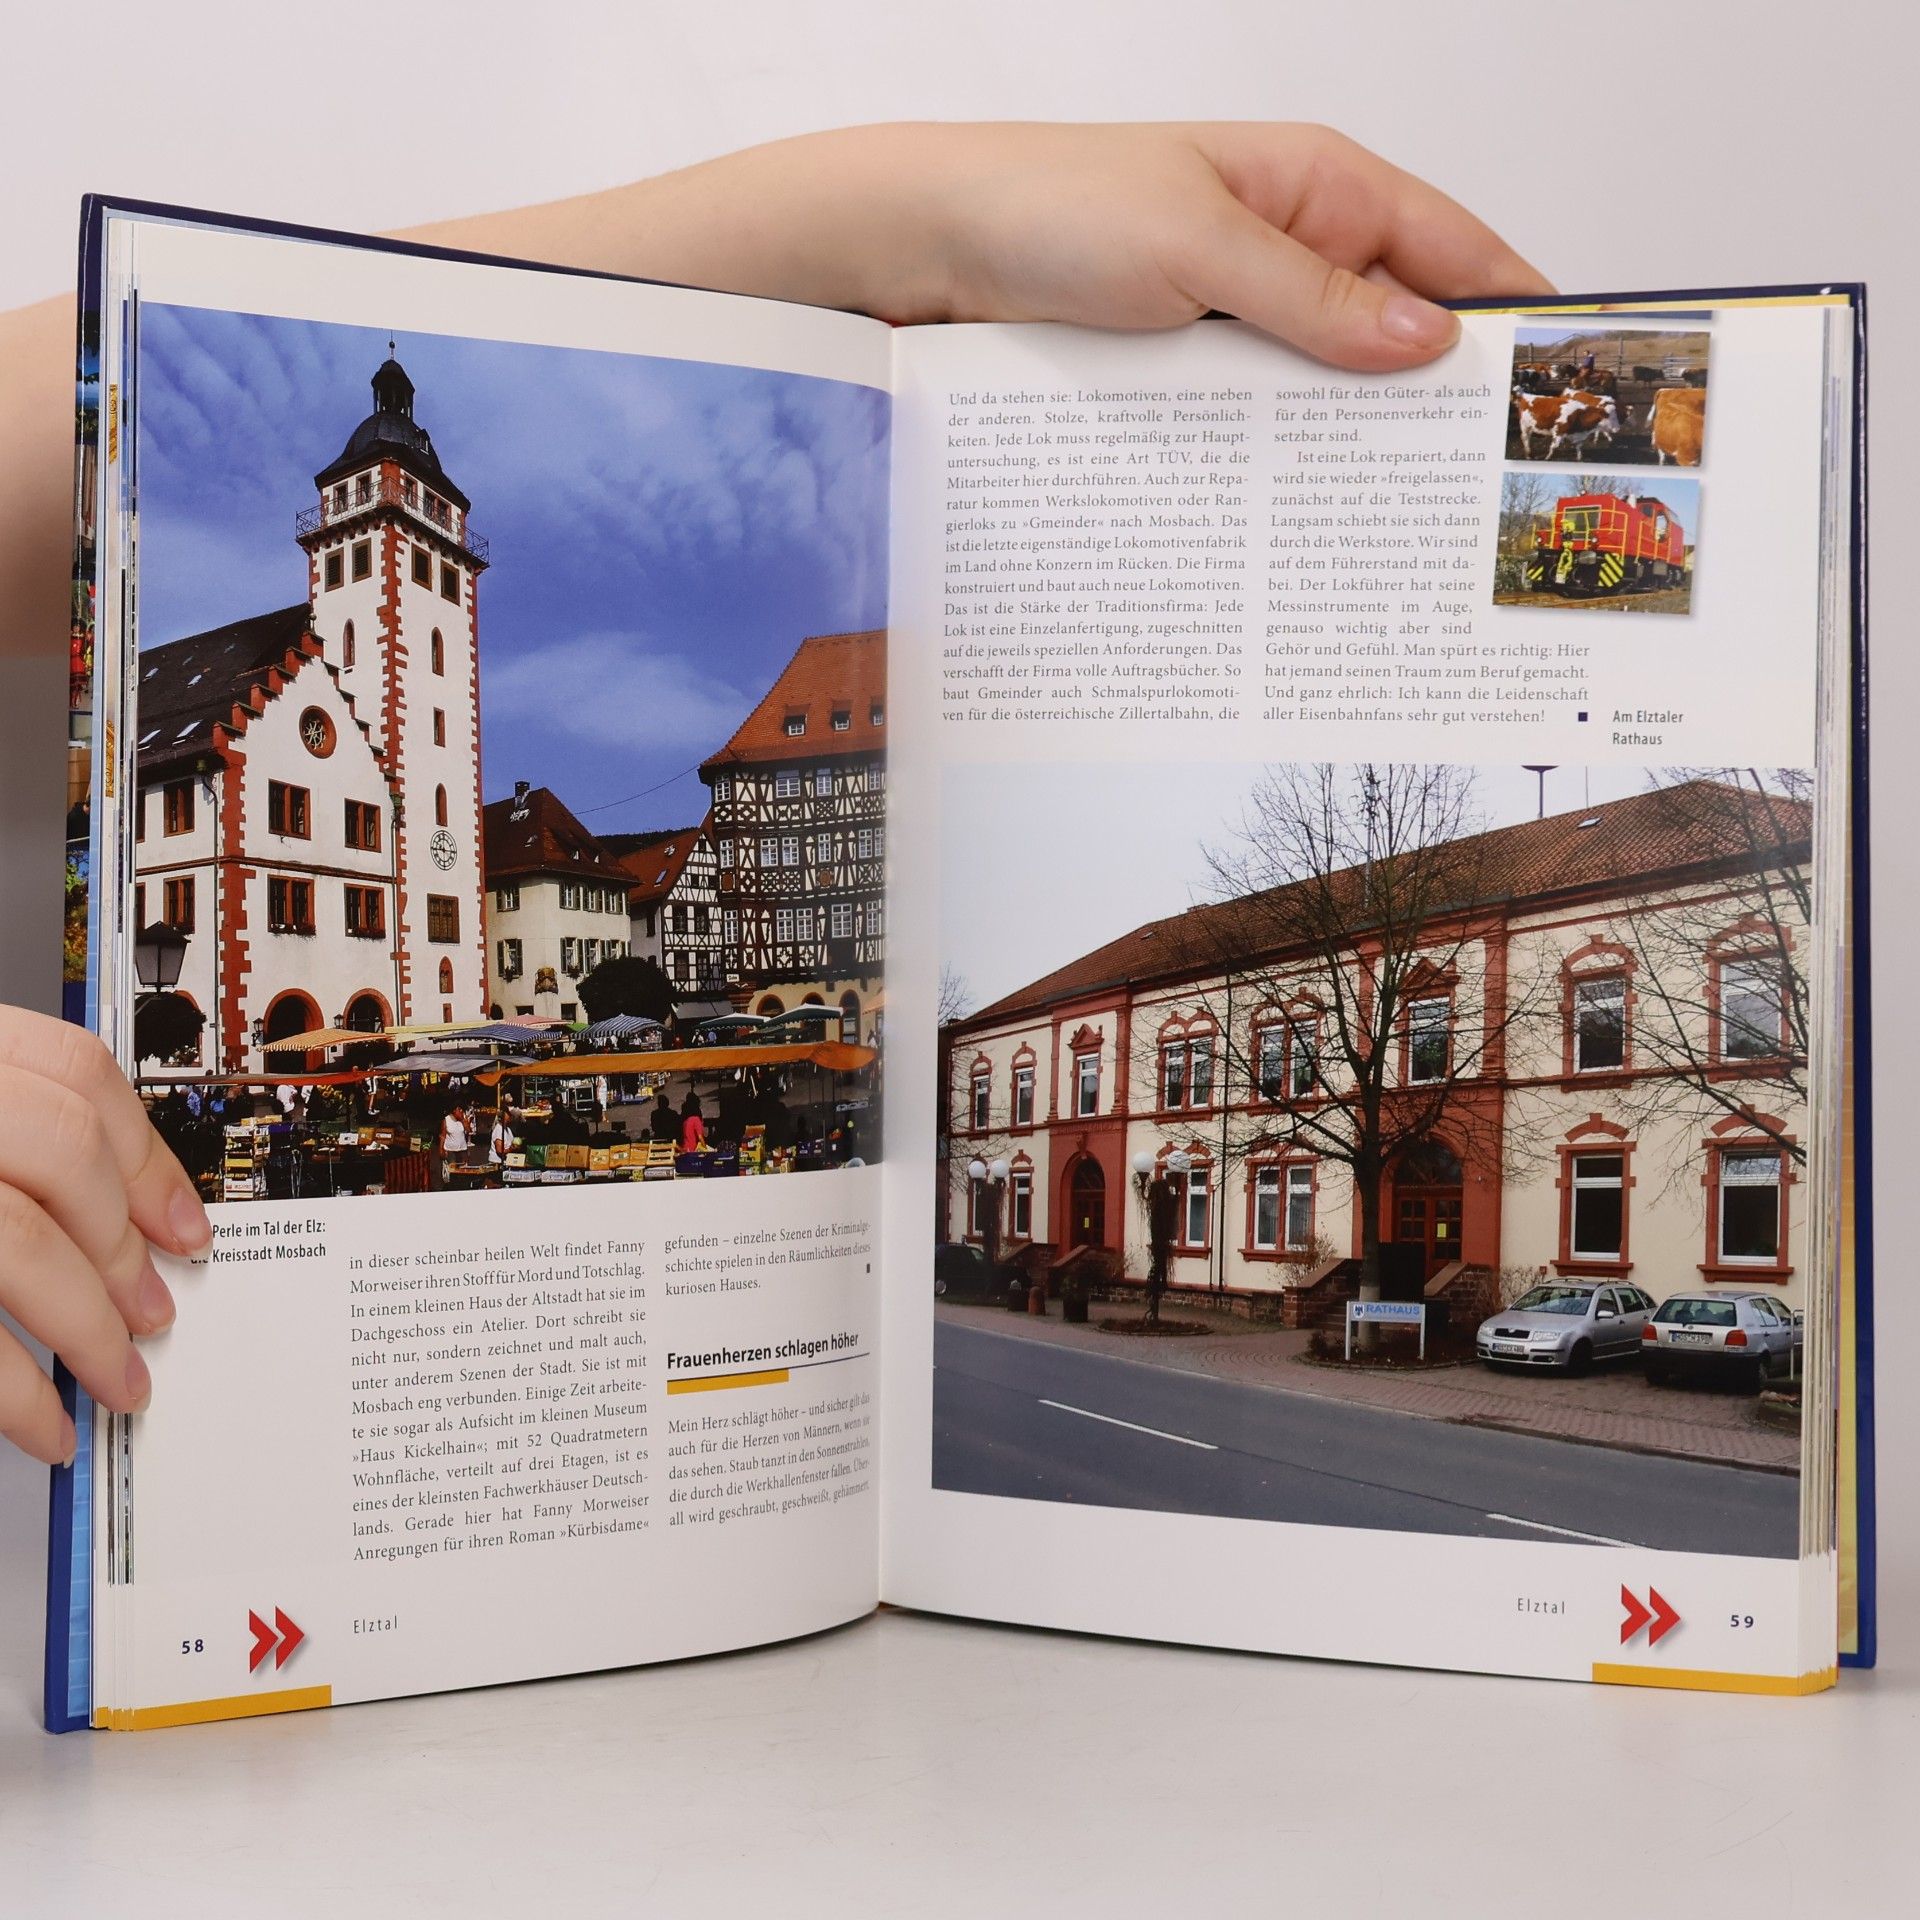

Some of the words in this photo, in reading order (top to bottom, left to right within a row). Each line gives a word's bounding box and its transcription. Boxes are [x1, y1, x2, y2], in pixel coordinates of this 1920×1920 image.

[949, 392, 977, 405] Und
[981, 392, 997, 405] da
[1002, 390, 1045, 404] stehen
[1050, 391, 1072, 403] sie:
[1077, 388, 1172, 402] Lokomotiven,
[1176, 389, 1206, 401] eine
[1210, 387, 1252, 401] neben
[1275, 387, 1325, 400] sowohl
[1329, 386, 1351, 400] für
[1354, 386, 1380, 400] den
[1384, 386, 1430, 399] Güter-
[1434, 385, 1454, 398] als
[1457, 383, 1491, 398] auch
[948, 413, 970, 427] der
[978, 411, 1035, 426] anderen.
[1044, 410, 1088, 424] Stolze,
[1097, 408, 1163, 423] kraftvolle
[1173, 408, 1251, 422] Persönlich-
[1274, 408, 1297, 422] für
[1302, 408, 1328, 421] den
[1335, 406, 1454, 420] Personenverkehr
[1460, 407, 1489, 419] ein-
[1274, 429, 1325, 442] setzbar
[1328, 429, 1362, 442] sind.
[947, 454, 1040, 470] untersuchung,
[1047, 456, 1061, 466] es
[1068, 454, 1084, 465] ist
[1090, 452, 1119, 465] eine
[1126, 452, 1149, 465] Art
[1156, 449, 1193, 464] TÜV,
[1200, 450, 1222, 464] die
[1228, 451, 1251, 464] die
[946, 499, 978, 511] ratur
[982, 496, 1040, 509] kommen
[1045, 493, 1172, 507] Werkslokomotiven
[1177, 493, 1209, 506] oder
[1215, 494, 1247, 506] Ran-
[1271, 514, 1333, 531] Langsam
[1337, 513, 1386, 527] schiebt
[1390, 514, 1410, 527] sie
[1412, 513, 1440, 526] sich
[1444, 512, 1480, 526] dann
[945, 562, 961, 574] im
[964, 559, 997, 573] Land
[999, 559, 1033, 572] ohne
[1036, 559, 1092, 571] Konzern
[1096, 558, 1114, 570] im
[1117, 556, 1172, 570] Rücken.
[1177, 557, 1201, 570] Die
[1204, 556, 1246, 570] Firma
[1268, 577, 1293, 591] bei.
[1299, 578, 1326, 591] Der
[1332, 577, 1405, 591] Lokführer
[1410, 578, 1432, 591] hat
[1439, 579, 1476, 591] seine
[1267, 599, 1390, 614] Messinstrumente
[1401, 600, 1420, 613] im
[1432, 600, 1473, 616] Auge,
[944, 623, 968, 637] Lok
[971, 624, 986, 636] ist
[989, 623, 1016, 635] eine
[1020, 620, 1143, 638] Einzelanfertigung,
[1147, 621, 1243, 638] zugeschnitten
[1265, 642, 1311, 655] Gehör
[1314, 641, 1342, 655] und
[1345, 643, 1399, 656] Gefühl.
[1403, 643, 1436, 656] Man
[1440, 644, 1477, 660] spürt
[1481, 647, 1496, 656] es
[1500, 643, 1552, 661] richtig:
[1557, 644, 1590, 657] Hier
[942, 687, 969, 700] baut
[977, 686, 1043, 700] Gmeinder
[1051, 685, 1082, 698] auch
[1091, 684, 1240, 702] Schmalspurlokomoti-
[1263, 706, 1295, 720] aller
[1299, 707, 1403, 721] Eisenbahnfans
[1407, 708, 1438, 722] sehr
[1442, 711, 1465, 726] gut
[1470, 708, 1545, 722] verstehen!
[1612, 710, 1633, 723] Am
[1636, 710, 1684, 724] Elztaler
[1612, 732, 1663, 745] Rathaus
[212, 1223, 242, 1238] Perle
[245, 1223, 260, 1237] im
[263, 1220, 280, 1236] Tal
[283, 1220, 303, 1235] der
[306, 1219, 326, 1233] Elz:
[664, 1234, 719, 1254] gefunden
[733, 1229, 777, 1245] einzelne
[780, 1228, 812, 1241] Szenen
[814, 1224, 829, 1238] der
[212, 1246, 272, 1263] Kreisstadt
[275, 1243, 326, 1259] Mosbach
[349, 1257, 363, 1270] in
[368, 1254, 410, 1269] dieser
[415, 1248, 480, 1266] scheinbar
[484, 1246, 525, 1262] heilen
[530, 1244, 560, 1259] Welt
[564, 1241, 602, 1257] findet
[607, 1240, 645, 1256] Fanny
[665, 1282, 716, 1296] kuriosen
[720, 1278, 761, 1292] Hauses.
[1366, 1304, 1420, 1315] RATHAUS
[351, 1323, 446, 1344] Dachgeschoss
[452, 1322, 473, 1335] ein
[481, 1317, 528, 1332] Atelier.
[536, 1315, 566, 1329] Dort
[573, 1309, 623, 1326] schreibt
[630, 1308, 646, 1322] sie
[667, 1347, 772, 1369] Frauenherzen
[775, 1338, 828, 1358] schlagen
[831, 1332, 859, 1350] höher
[351, 1377, 389, 1390] unter
[394, 1371, 453, 1387] anderem
[460, 1368, 506, 1382] Szenen
[512, 1363, 534, 1378] der
[539, 1359, 576, 1376] Stadt.
[582, 1358, 600, 1372] Sie
[606, 1357, 620, 1370] ist
[626, 1355, 647, 1369] mit
[496, 1436, 518, 1450] mit
[527, 1433, 542, 1447] 52
[550, 1427, 648, 1448] Quadratmetern
[352, 1498, 388, 1512] eines
[391, 1493, 415, 1508] der
[418, 1490, 479, 1506] kleinsten
[484, 1479, 589, 1500] Fachwerkhäuser
[592, 1470, 648, 1488] Deutsch-
[669, 1511, 684, 1526] all
[688, 1507, 715, 1523] wird
[718, 1499, 779, 1525] geschraubt,
[353, 1543, 438, 1562] Anregungen
[443, 1536, 464, 1552] für
[469, 1534, 504, 1549] ihren
[509, 1530, 555, 1544] Roman
[1517, 1598, 1565, 1615] Elztal
[353, 1615, 399, 1634] Elztal
[1730, 1614, 1755, 1629] 59
[181, 1638, 205, 1655] 58
